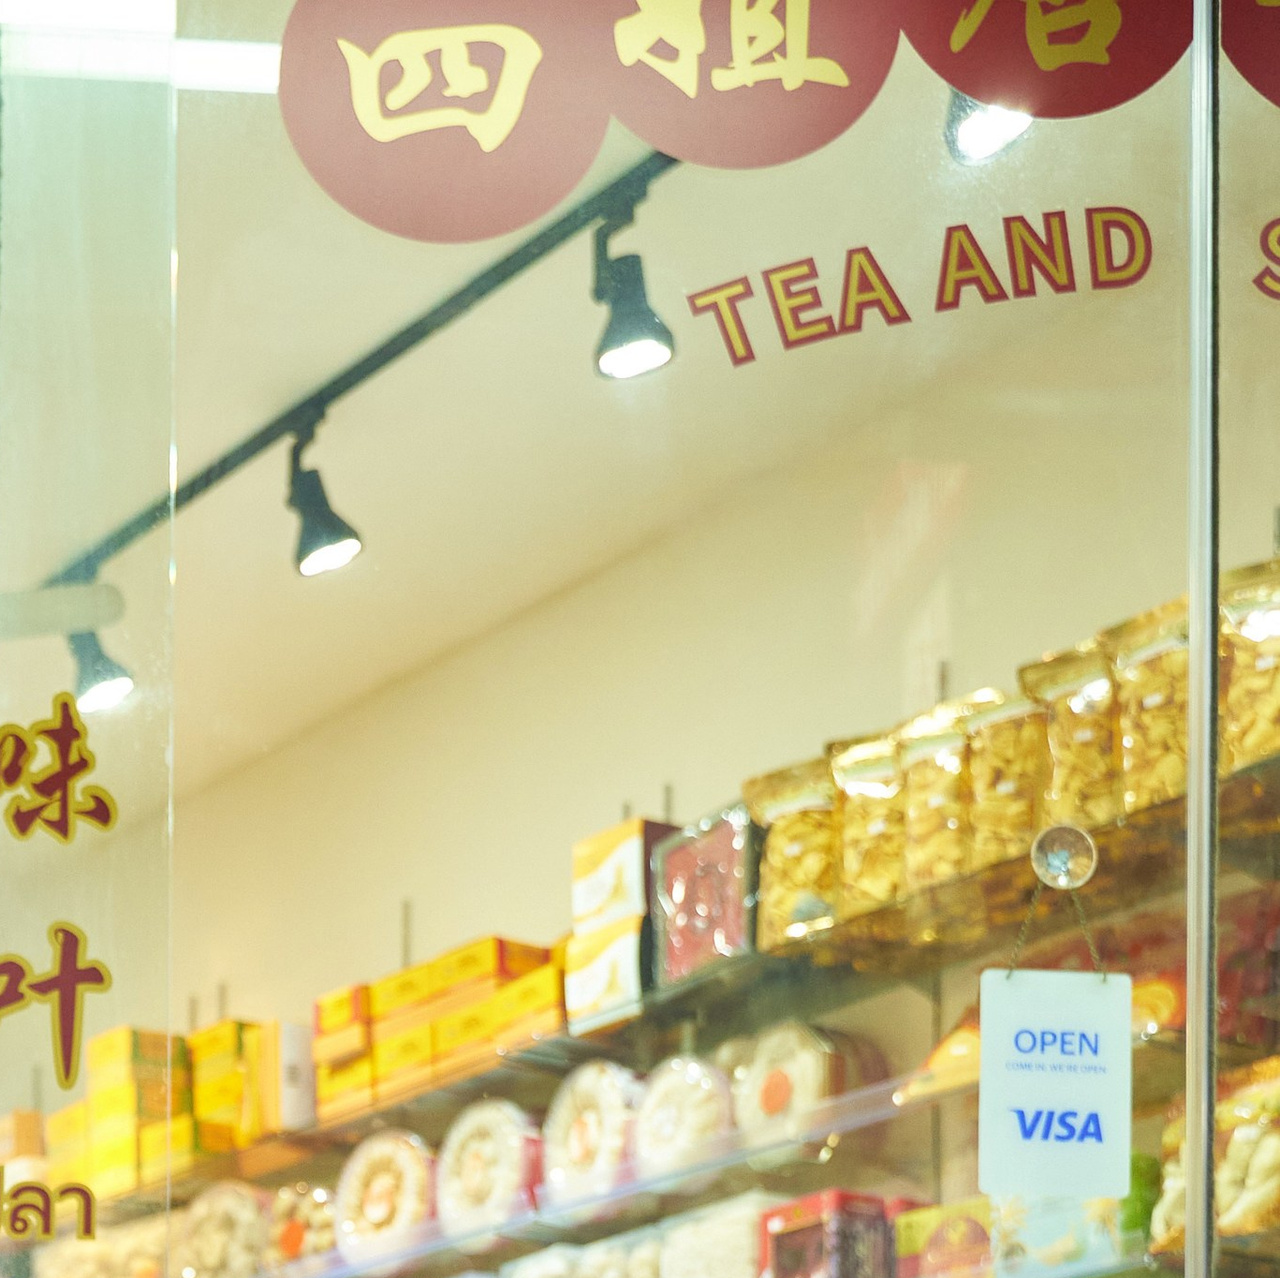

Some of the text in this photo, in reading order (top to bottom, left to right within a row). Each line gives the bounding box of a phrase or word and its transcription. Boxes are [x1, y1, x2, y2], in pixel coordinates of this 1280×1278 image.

[687, 245, 912, 367] TEA
[934, 205, 1154, 312] AND
[1013, 1029, 1100, 1057] OPEN
[1009, 1108, 1104, 1144] VISA
